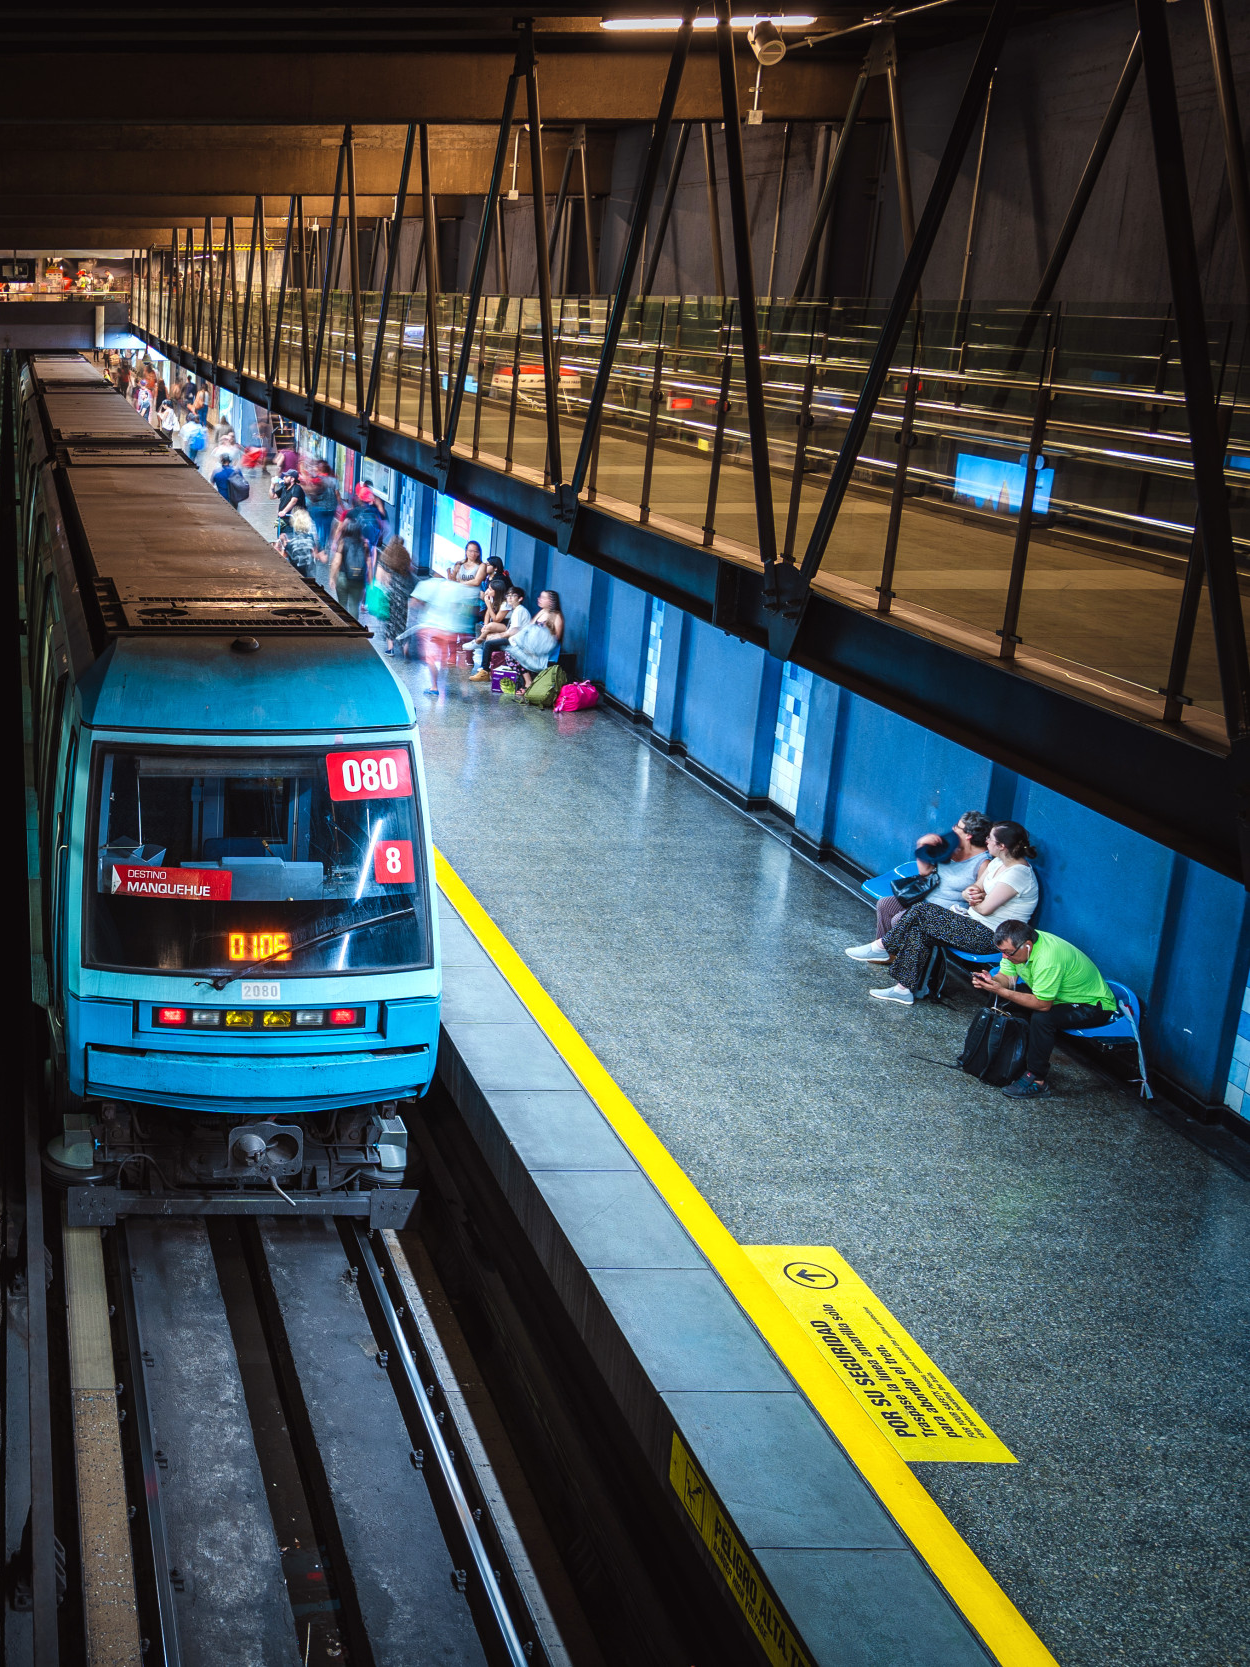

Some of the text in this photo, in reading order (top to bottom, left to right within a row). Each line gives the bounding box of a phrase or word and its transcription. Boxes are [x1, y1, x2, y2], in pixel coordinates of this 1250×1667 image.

[342, 757, 398, 792] 080
[127, 869, 167, 880] DESTINO
[385, 847, 402, 874] 8
[127, 881, 211, 897] MANQUEHUE
[244, 985, 278, 997] 2080
[822, 1304, 844, 1321] sólo
[837, 1323, 873, 1358] amarilla
[809, 1320, 918, 1438] POR SU SEGURIDAD
[875, 1344, 963, 1438] para abordar el tren.
[886, 1383, 902, 1392] la
[895, 1394, 938, 1438] Traspase
[714, 1515, 758, 1606] PELIGRO
[759, 1596, 789, 1662] ALTA
